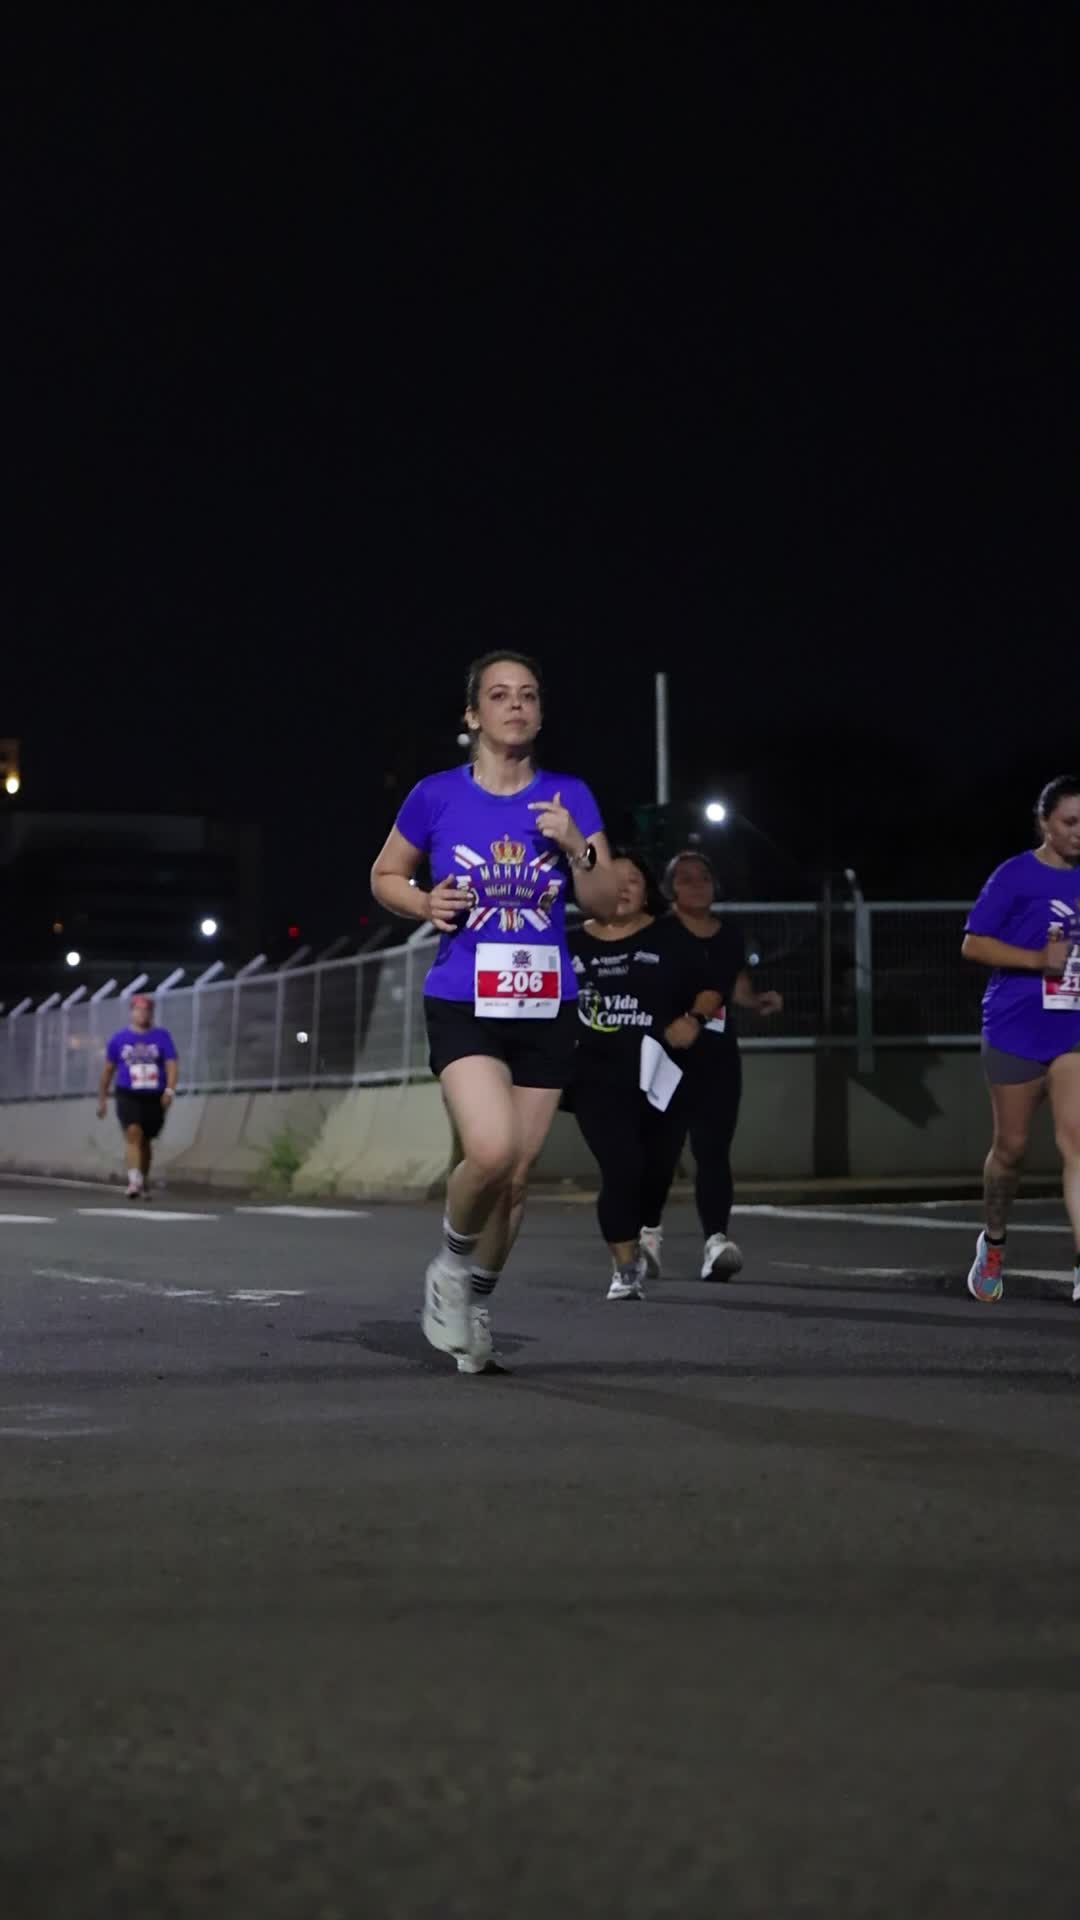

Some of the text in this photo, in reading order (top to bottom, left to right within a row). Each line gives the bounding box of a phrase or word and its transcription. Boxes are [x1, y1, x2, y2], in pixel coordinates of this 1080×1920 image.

[480, 864, 539, 882] MARVIN
[485, 884, 534, 898] NIGHT RUN
[497, 971, 543, 993] 206
[604, 995, 638, 1010] Vida
[597, 1010, 653, 1026] Corrida
